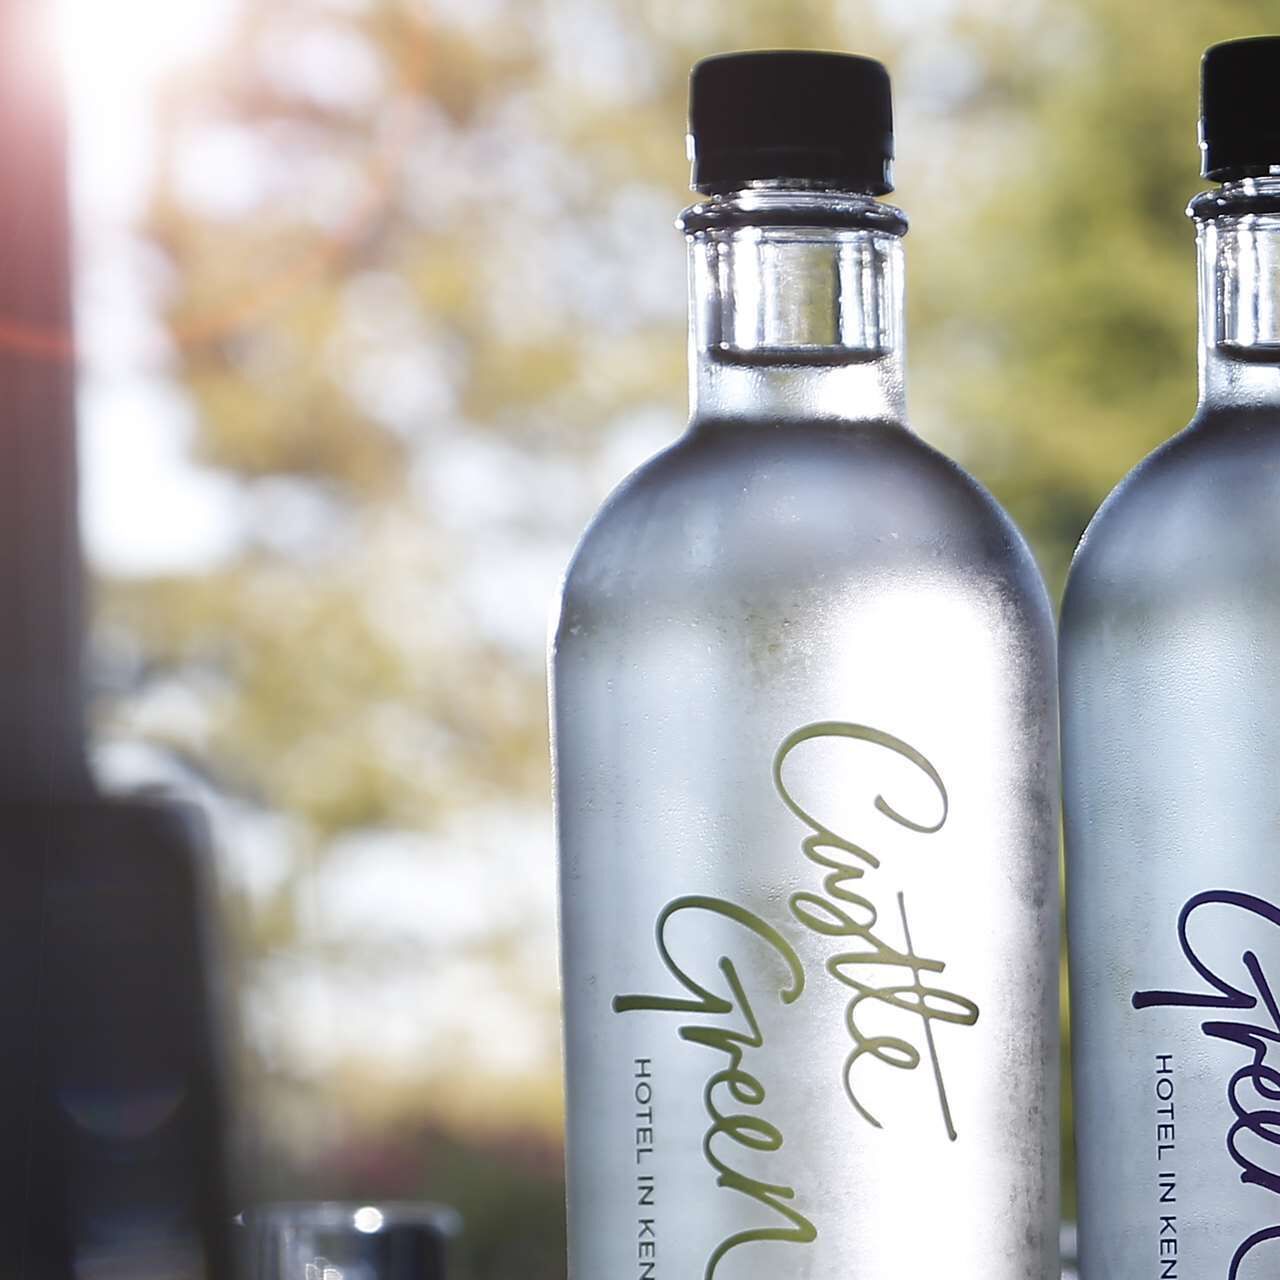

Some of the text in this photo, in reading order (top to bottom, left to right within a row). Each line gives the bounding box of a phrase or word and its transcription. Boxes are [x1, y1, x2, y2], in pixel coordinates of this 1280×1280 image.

[773, 720, 981, 1141] Castle
[634, 1058, 654, 1165] HOTEL
[1155, 1054, 1175, 1161] HOTEL
[637, 1176, 655, 1206] IN
[1158, 1172, 1177, 1203] IN
